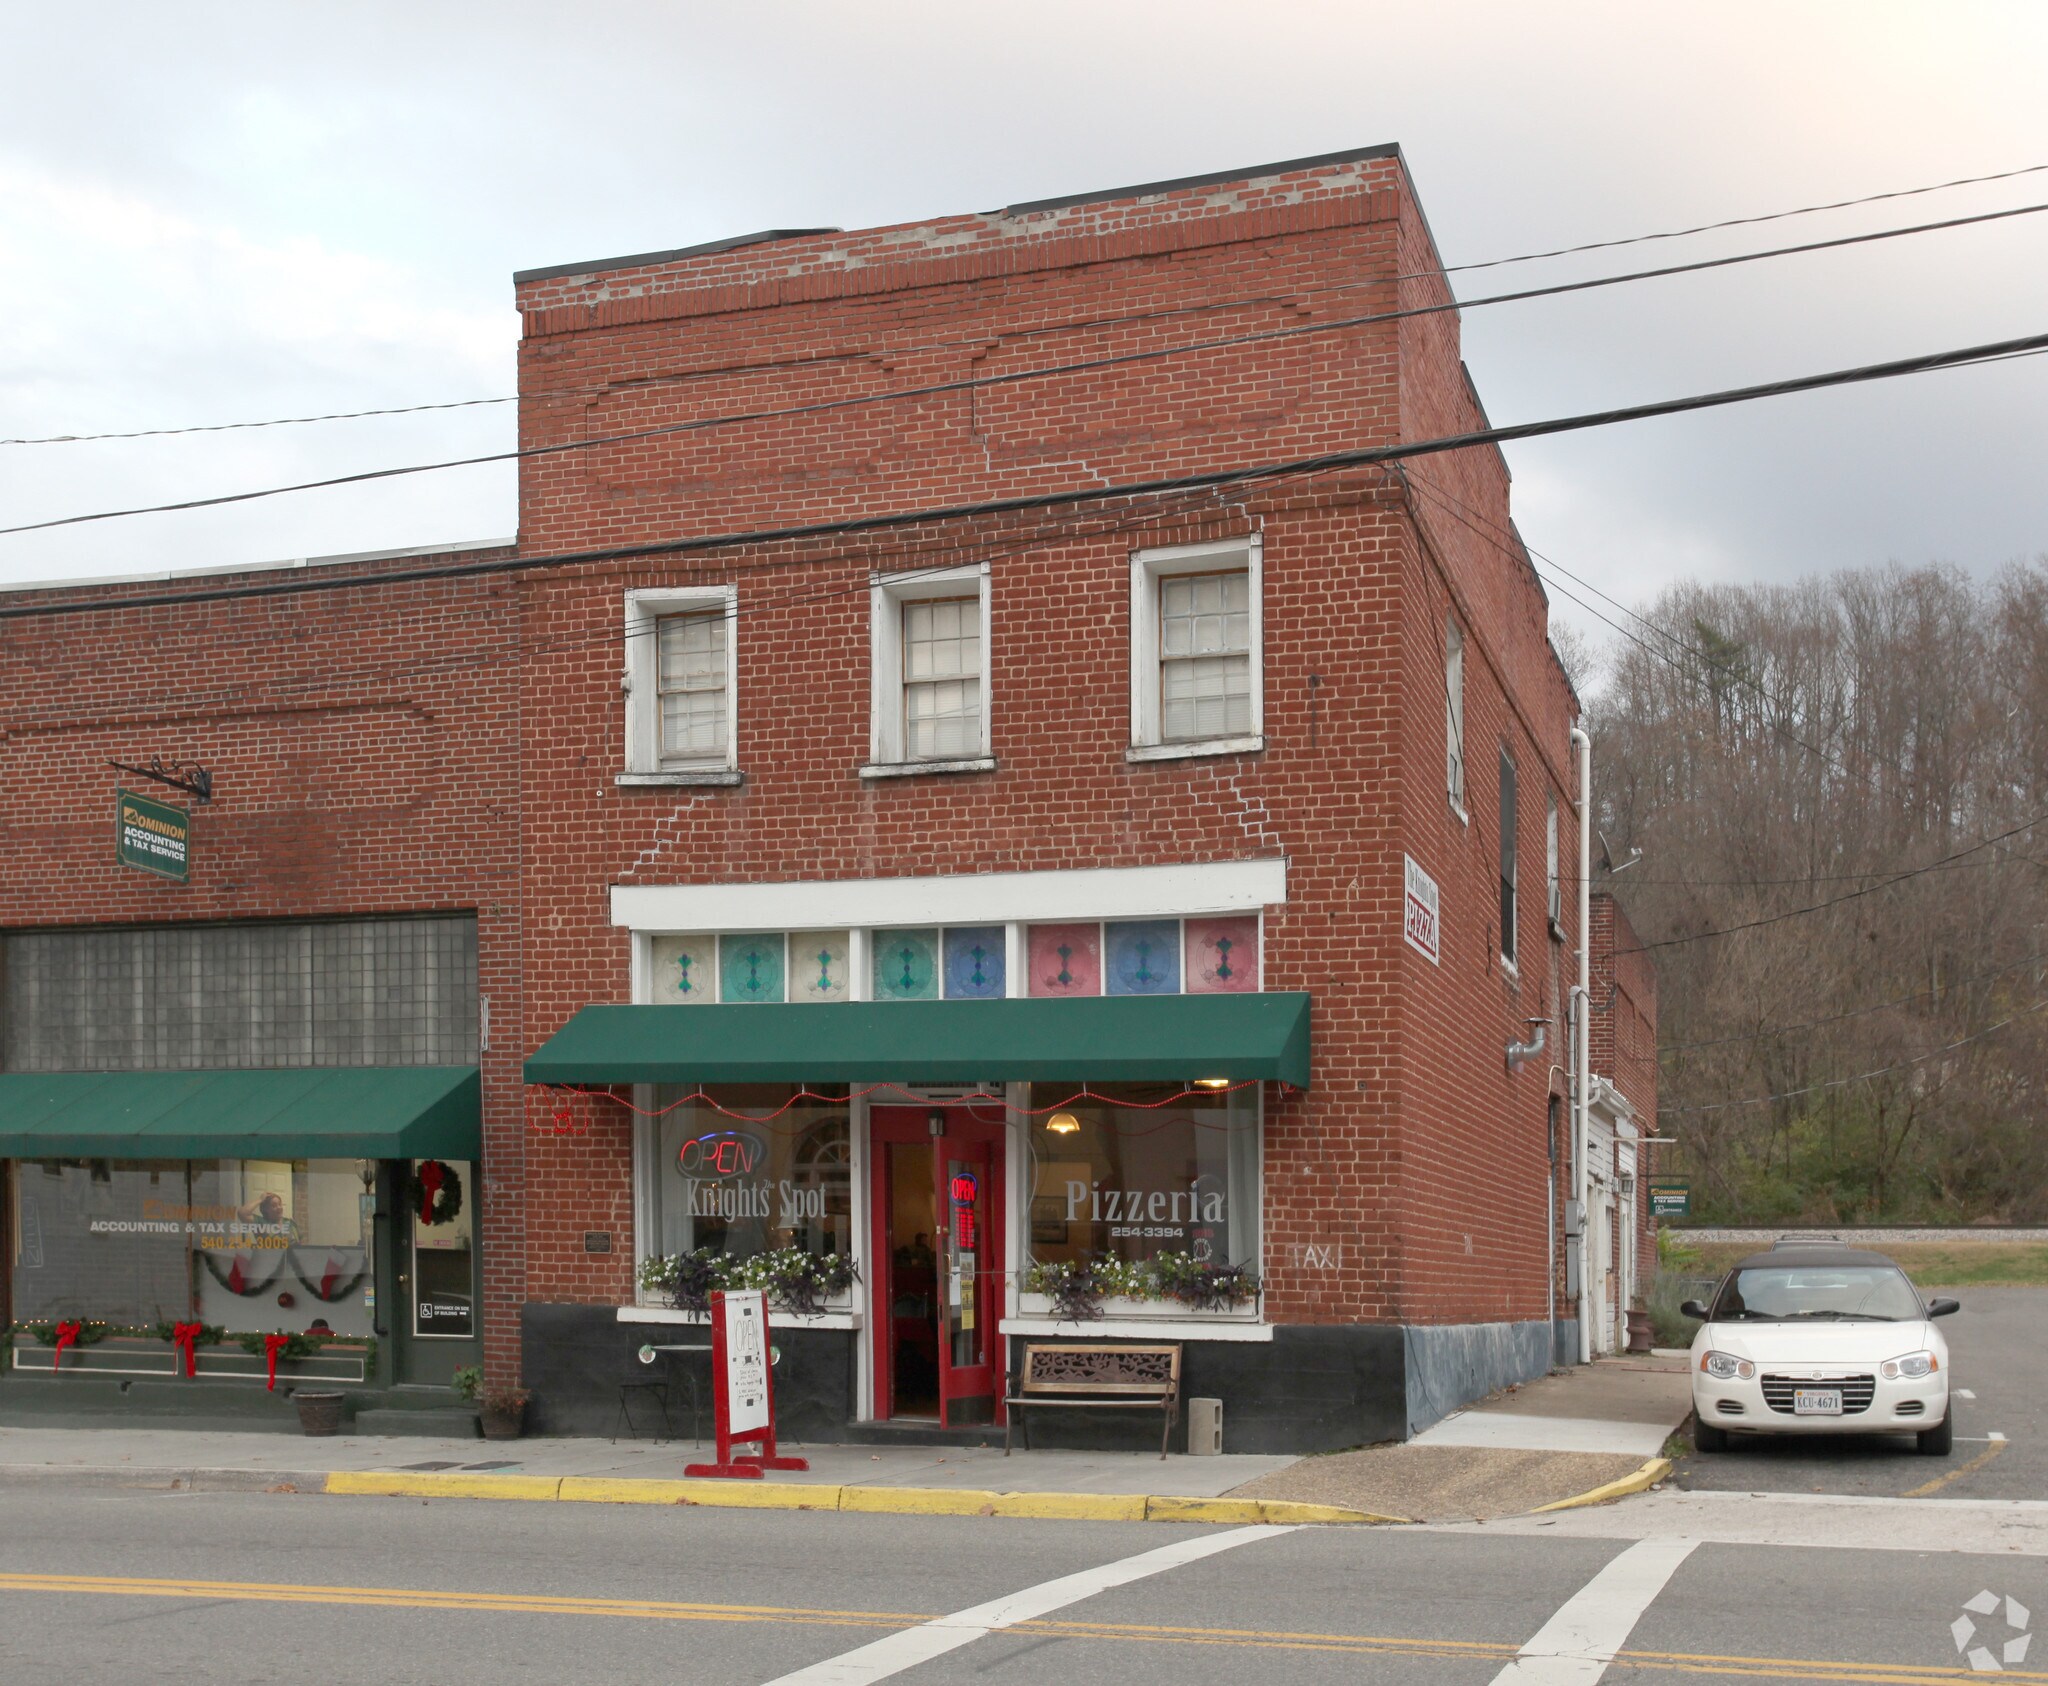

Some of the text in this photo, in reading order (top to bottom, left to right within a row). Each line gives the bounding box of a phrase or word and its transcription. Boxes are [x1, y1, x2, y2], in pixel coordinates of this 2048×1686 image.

[124, 826, 185, 852] ACCOUNTING
[124, 836, 185, 862] & TAX SERVICE
[1407, 895, 1437, 955] PIZZA
[680, 1139, 755, 1173] OPEN
[685, 1178, 828, 1225] Knights Spot
[951, 1177, 976, 1202] OPEN
[1065, 1180, 1227, 1224] Pizzeria
[90, 1221, 290, 1234] ACCOUNTING & TAX SERVICE
[1111, 1226, 1184, 1238] 254-3394
[735, 1319, 760, 1352] OPEN
